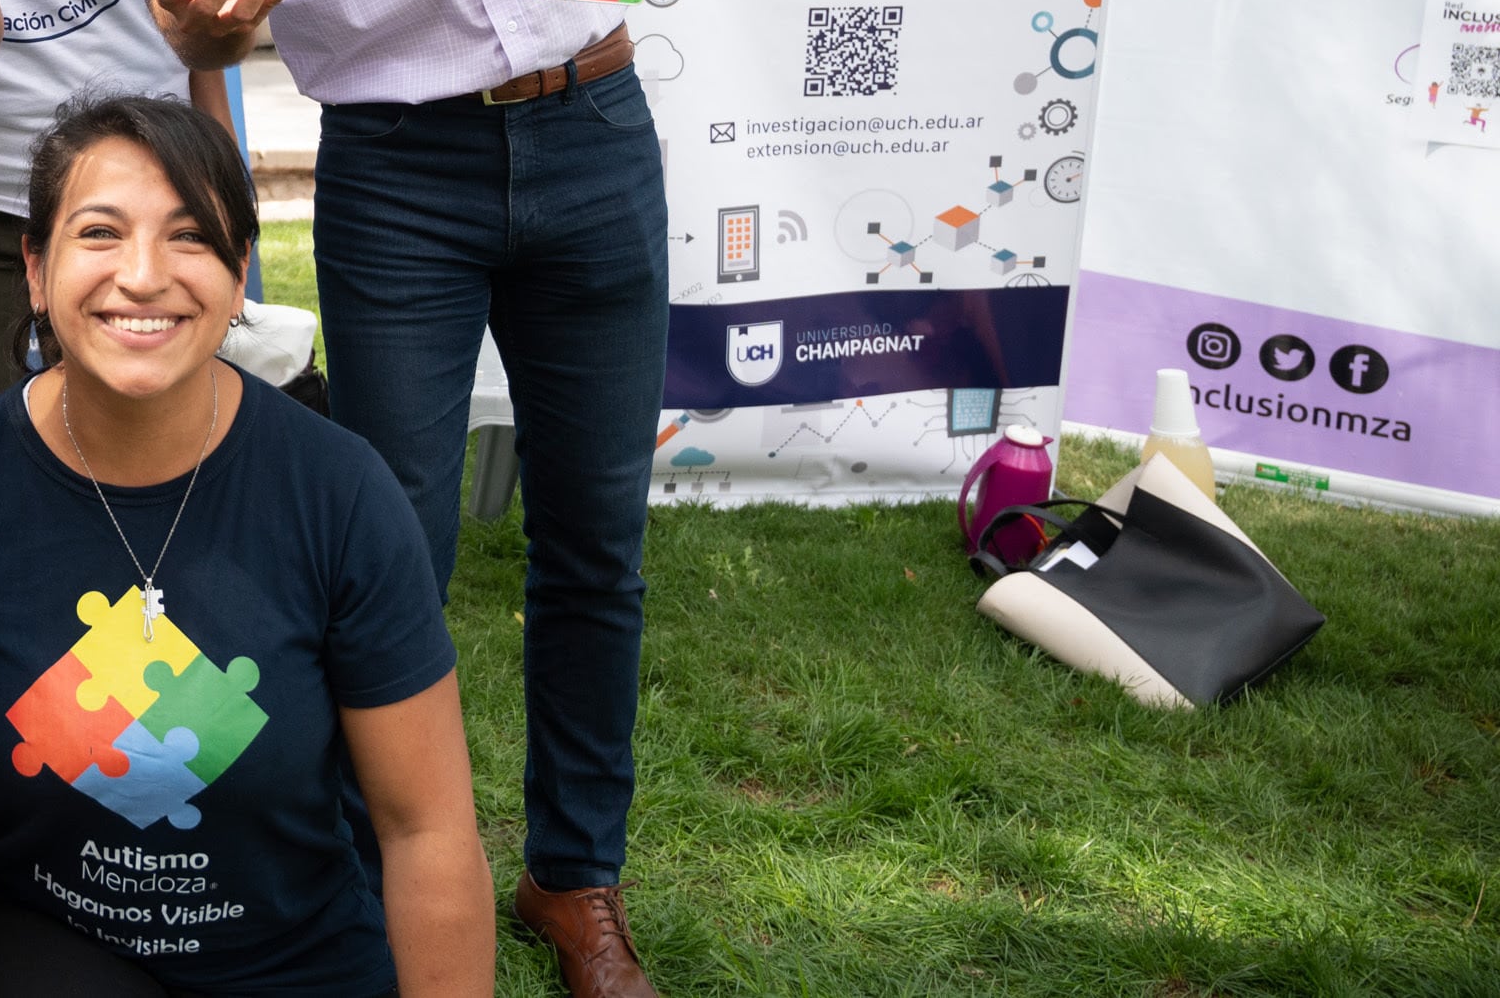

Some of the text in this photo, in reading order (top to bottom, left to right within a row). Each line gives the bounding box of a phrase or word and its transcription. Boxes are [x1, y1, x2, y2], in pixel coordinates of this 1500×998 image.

[2, 11, 55, 32] ación
[1443, 8, 1500, 24] INCLUS
[1385, 93, 1415, 107] Seg
[746, 114, 985, 136] investigacion@uch.edu.ar
[746, 138, 950, 159] extension@uch.edu.ar
[795, 322, 893, 344] UNIVERSIDAD
[736, 343, 774, 363] UCH
[795, 334, 925, 363] CHAMPAGNAT
[1189, 383, 1412, 442] nclusionmza
[80, 839, 210, 871] Autismo
[33, 863, 245, 926] Hagamos Visible
